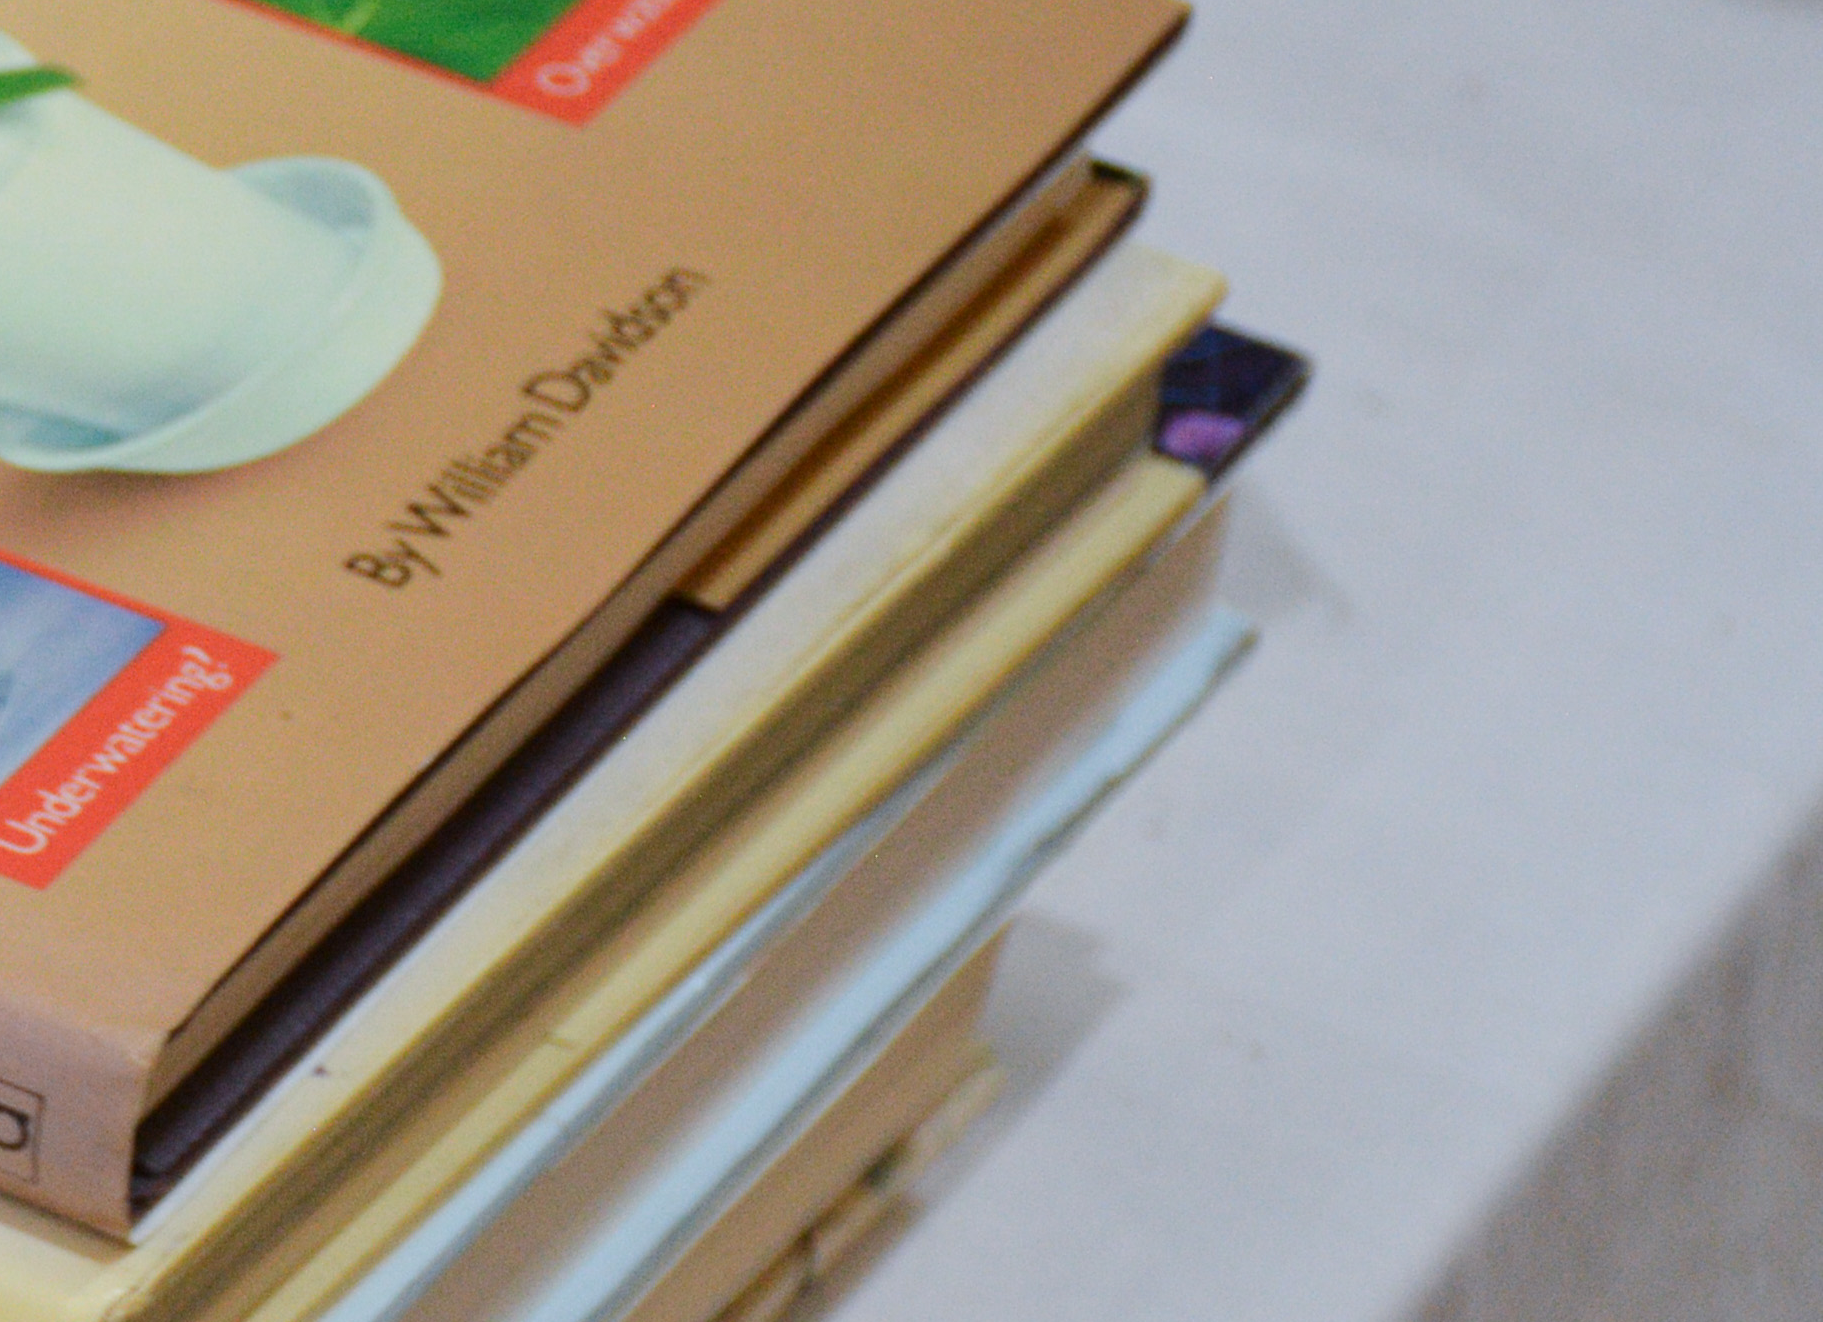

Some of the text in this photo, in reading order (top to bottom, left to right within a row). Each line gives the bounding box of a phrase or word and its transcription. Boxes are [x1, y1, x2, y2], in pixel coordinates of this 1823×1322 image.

[344, 266, 711, 589] By William Davidson
